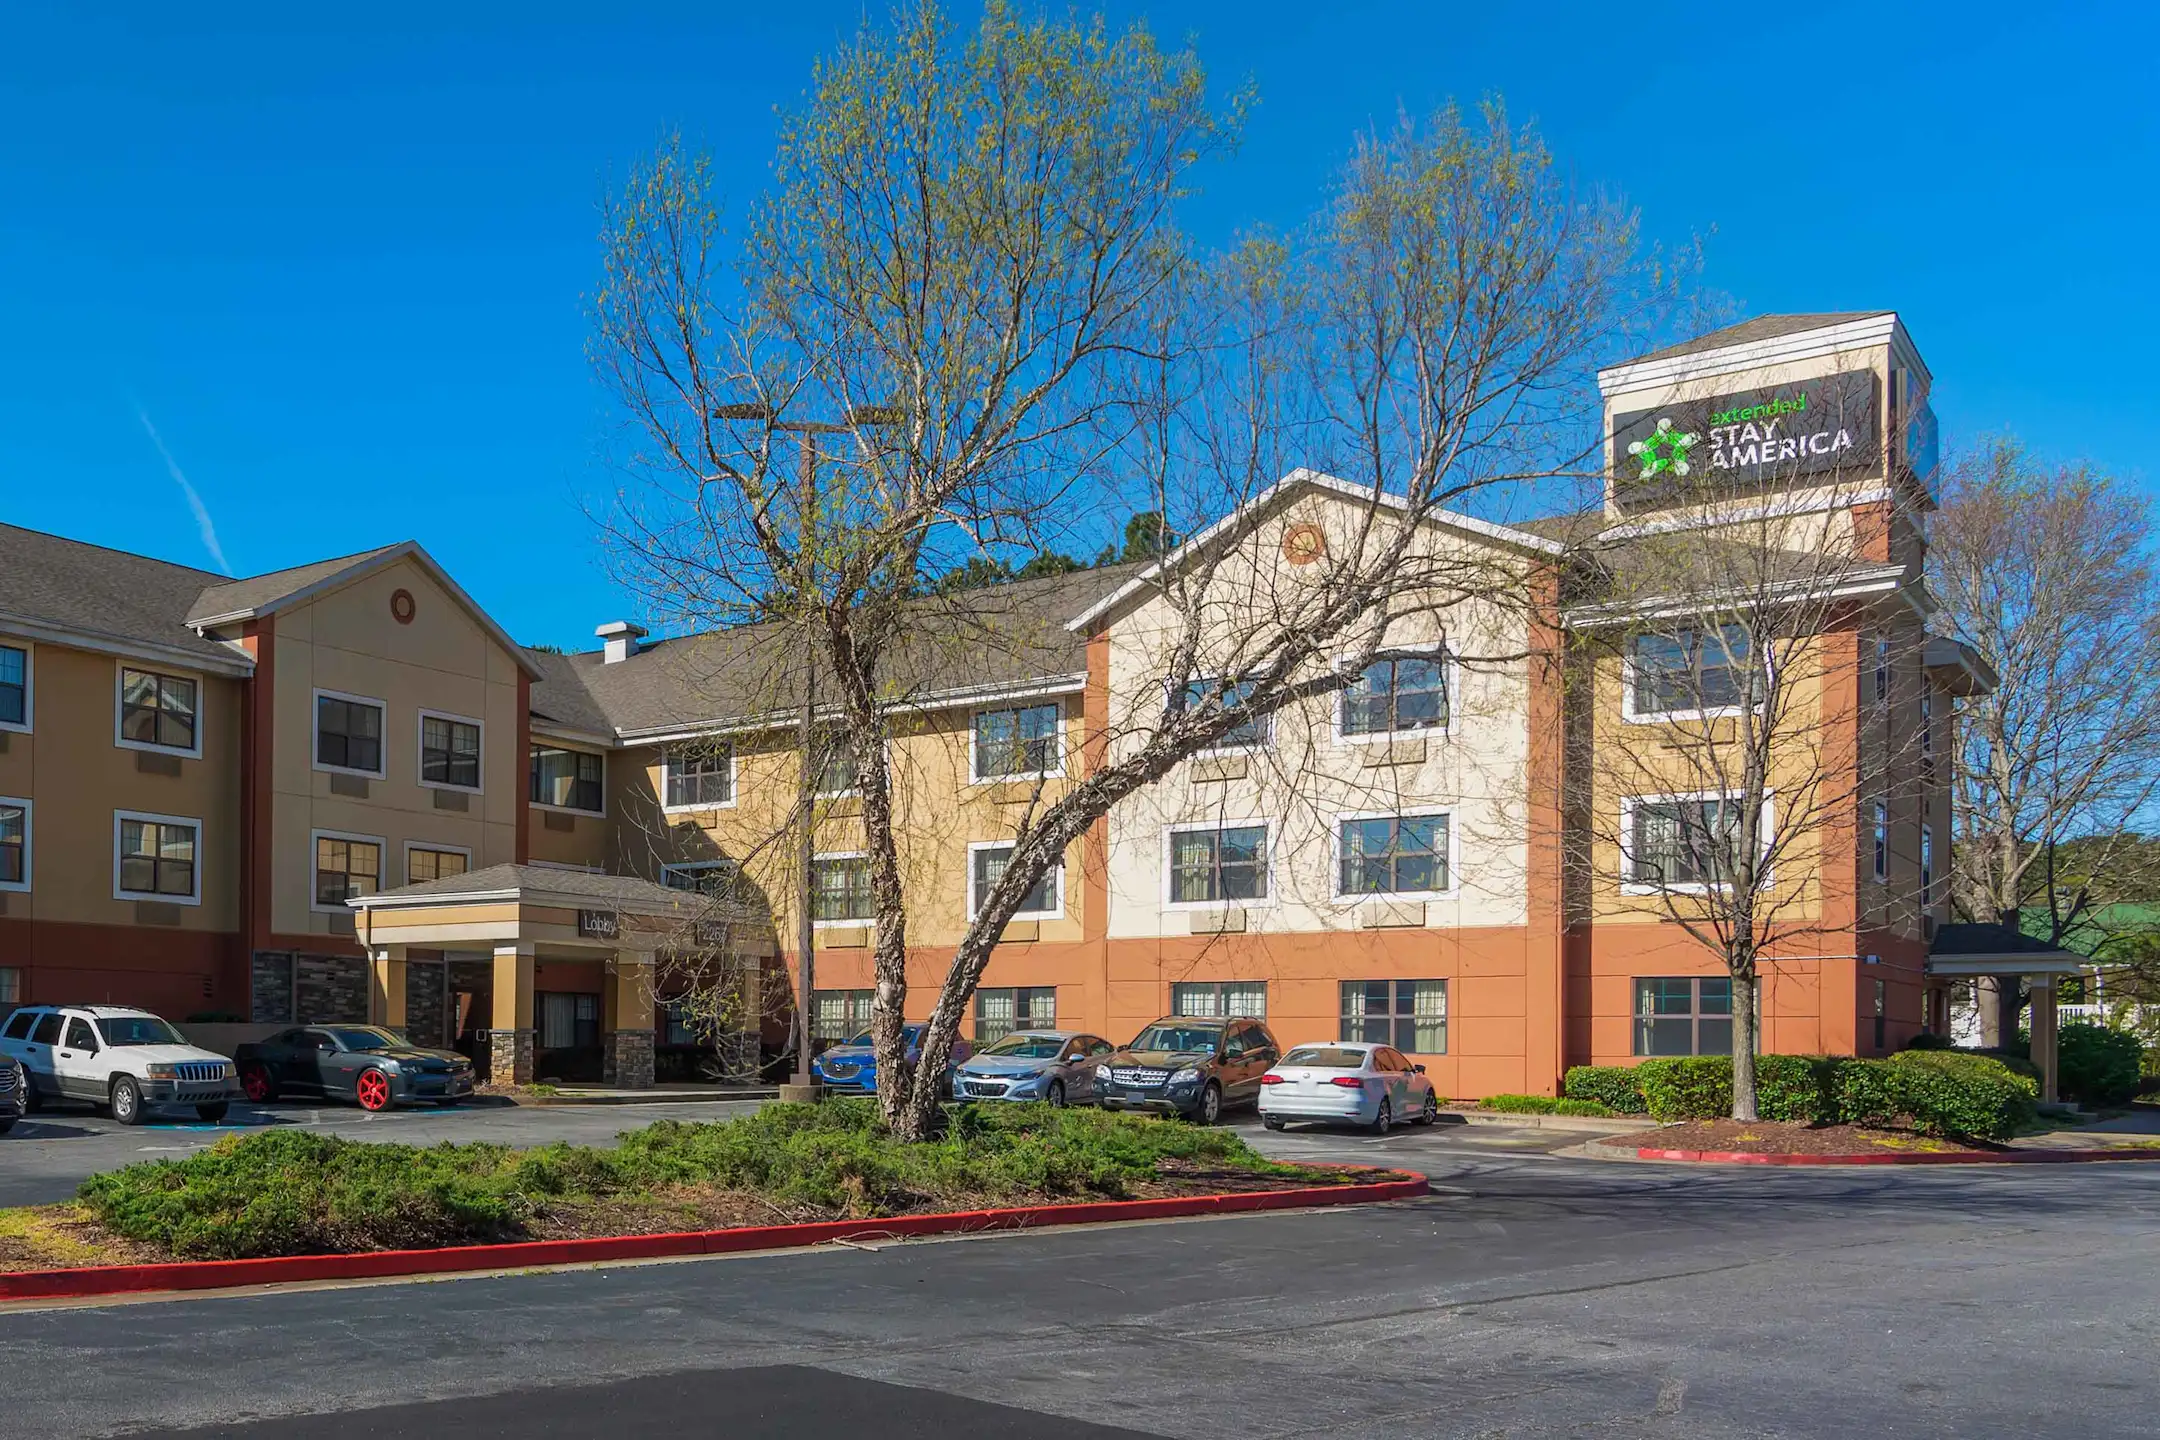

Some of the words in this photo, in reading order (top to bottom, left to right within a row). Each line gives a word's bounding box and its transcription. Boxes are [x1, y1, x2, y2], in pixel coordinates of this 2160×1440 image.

[1710, 393, 1807, 425] extended
[1708, 418, 1780, 449] STAY
[1712, 428, 1853, 469] AMERICA
[584, 915, 616, 936] Lobby
